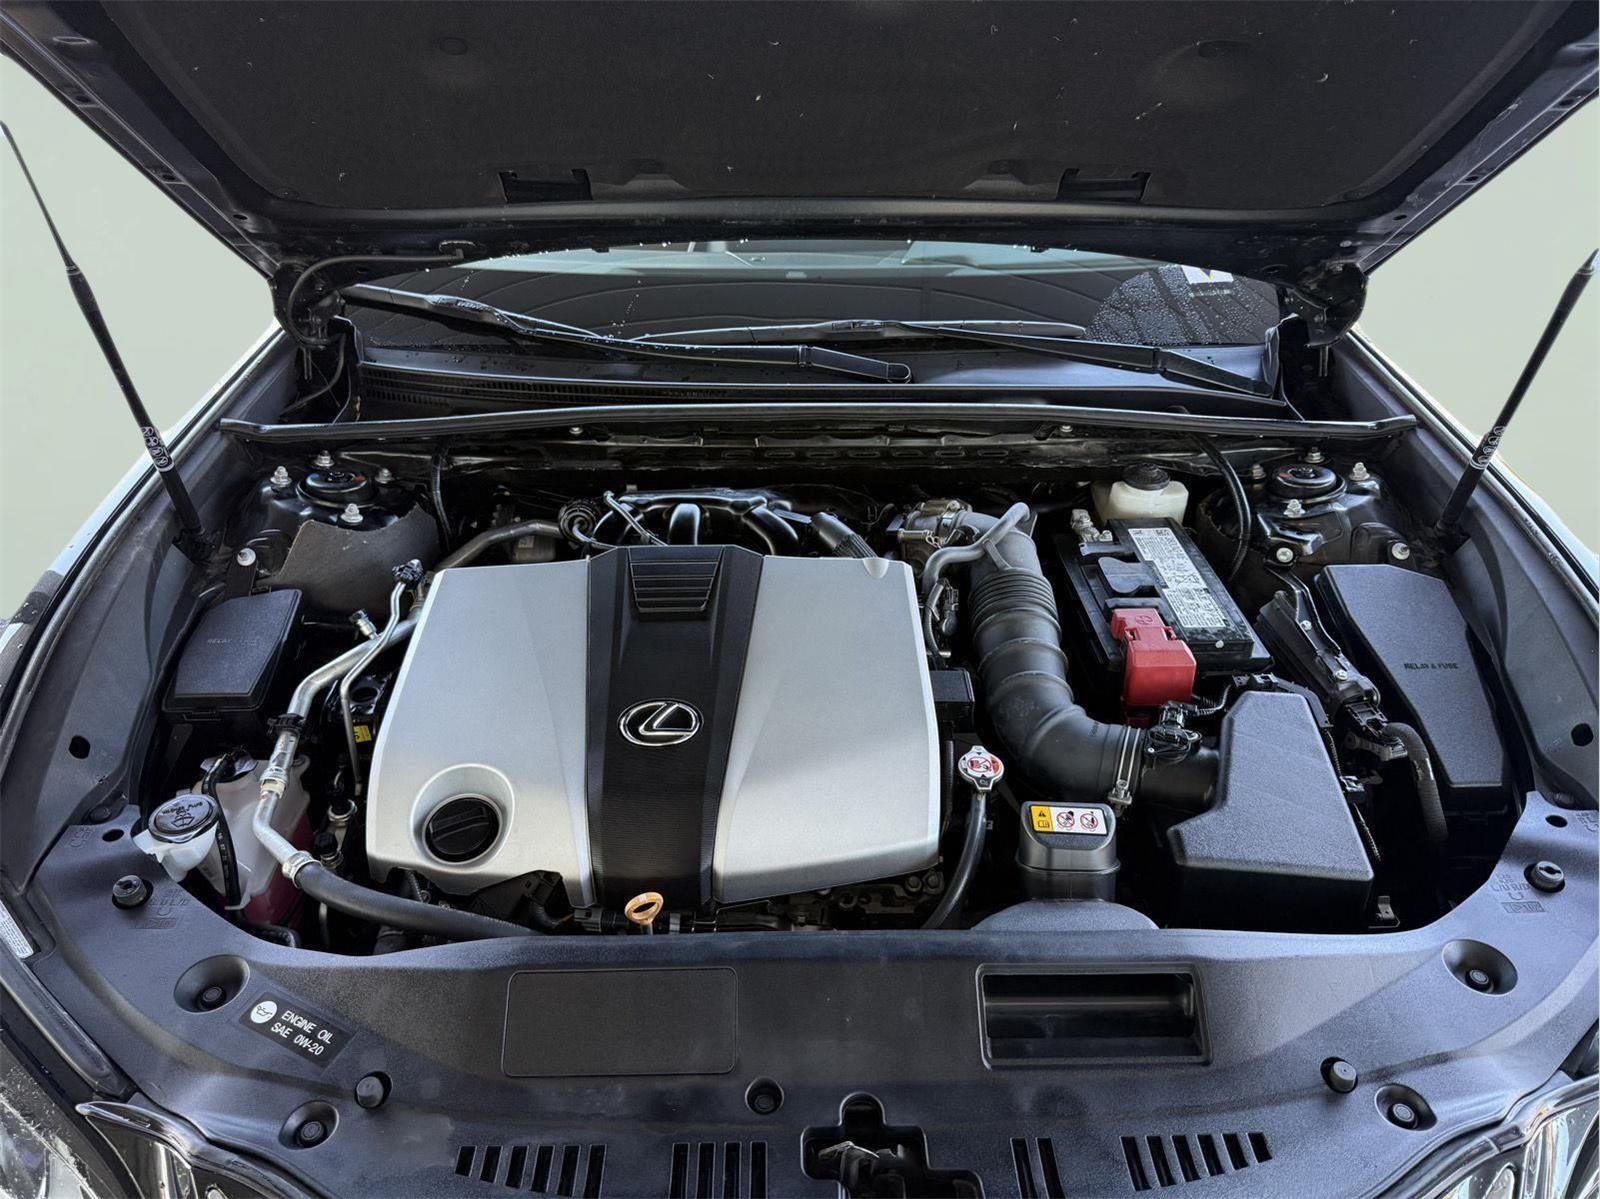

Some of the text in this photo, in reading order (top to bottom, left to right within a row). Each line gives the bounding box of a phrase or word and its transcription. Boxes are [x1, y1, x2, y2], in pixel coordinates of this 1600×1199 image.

[1403, 662, 1429, 670] RELAY
[271, 1022, 324, 1056] SAE 0W-20
[281, 1010, 335, 1044] ENGINE OIL
